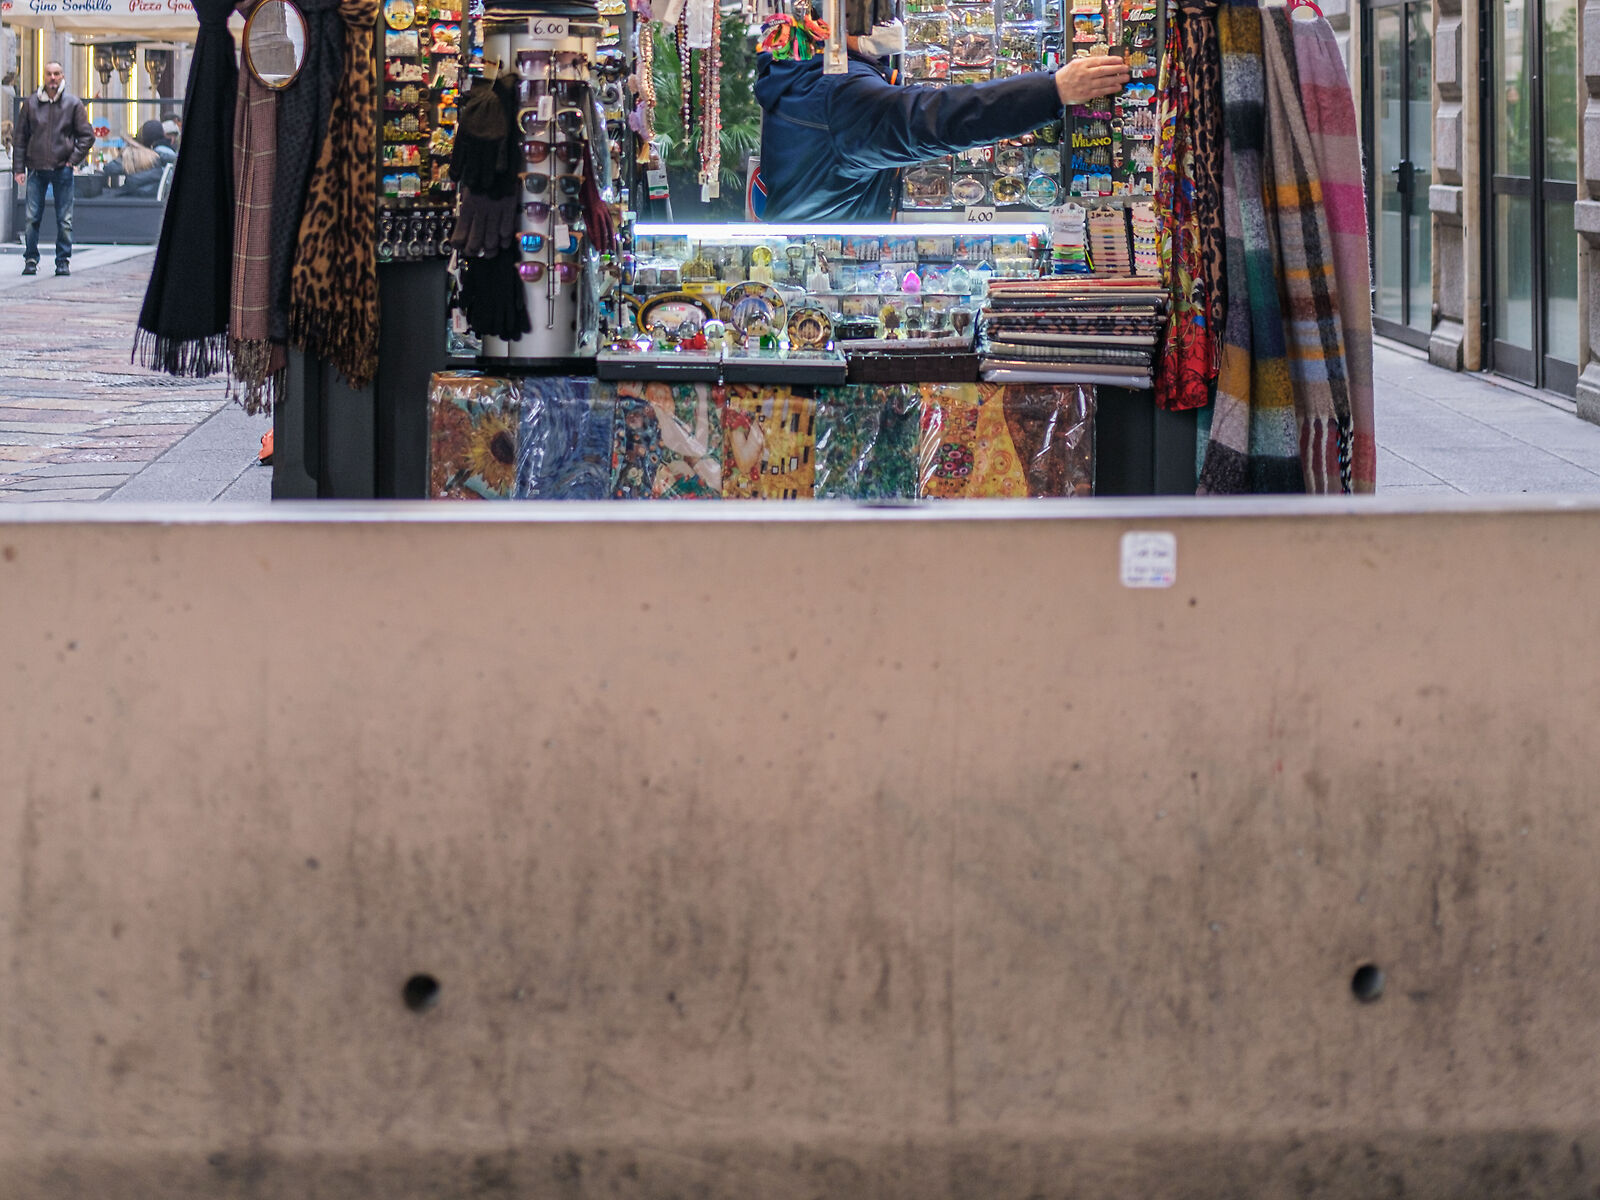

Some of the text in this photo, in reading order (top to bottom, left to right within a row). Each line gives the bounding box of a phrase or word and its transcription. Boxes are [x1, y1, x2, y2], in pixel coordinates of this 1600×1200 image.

[534, 19, 564, 35] 6.00
[1072, 133, 1112, 148] MILANO
[1071, 155, 1112, 173] MILANO
[968, 209, 993, 223] 4.00
